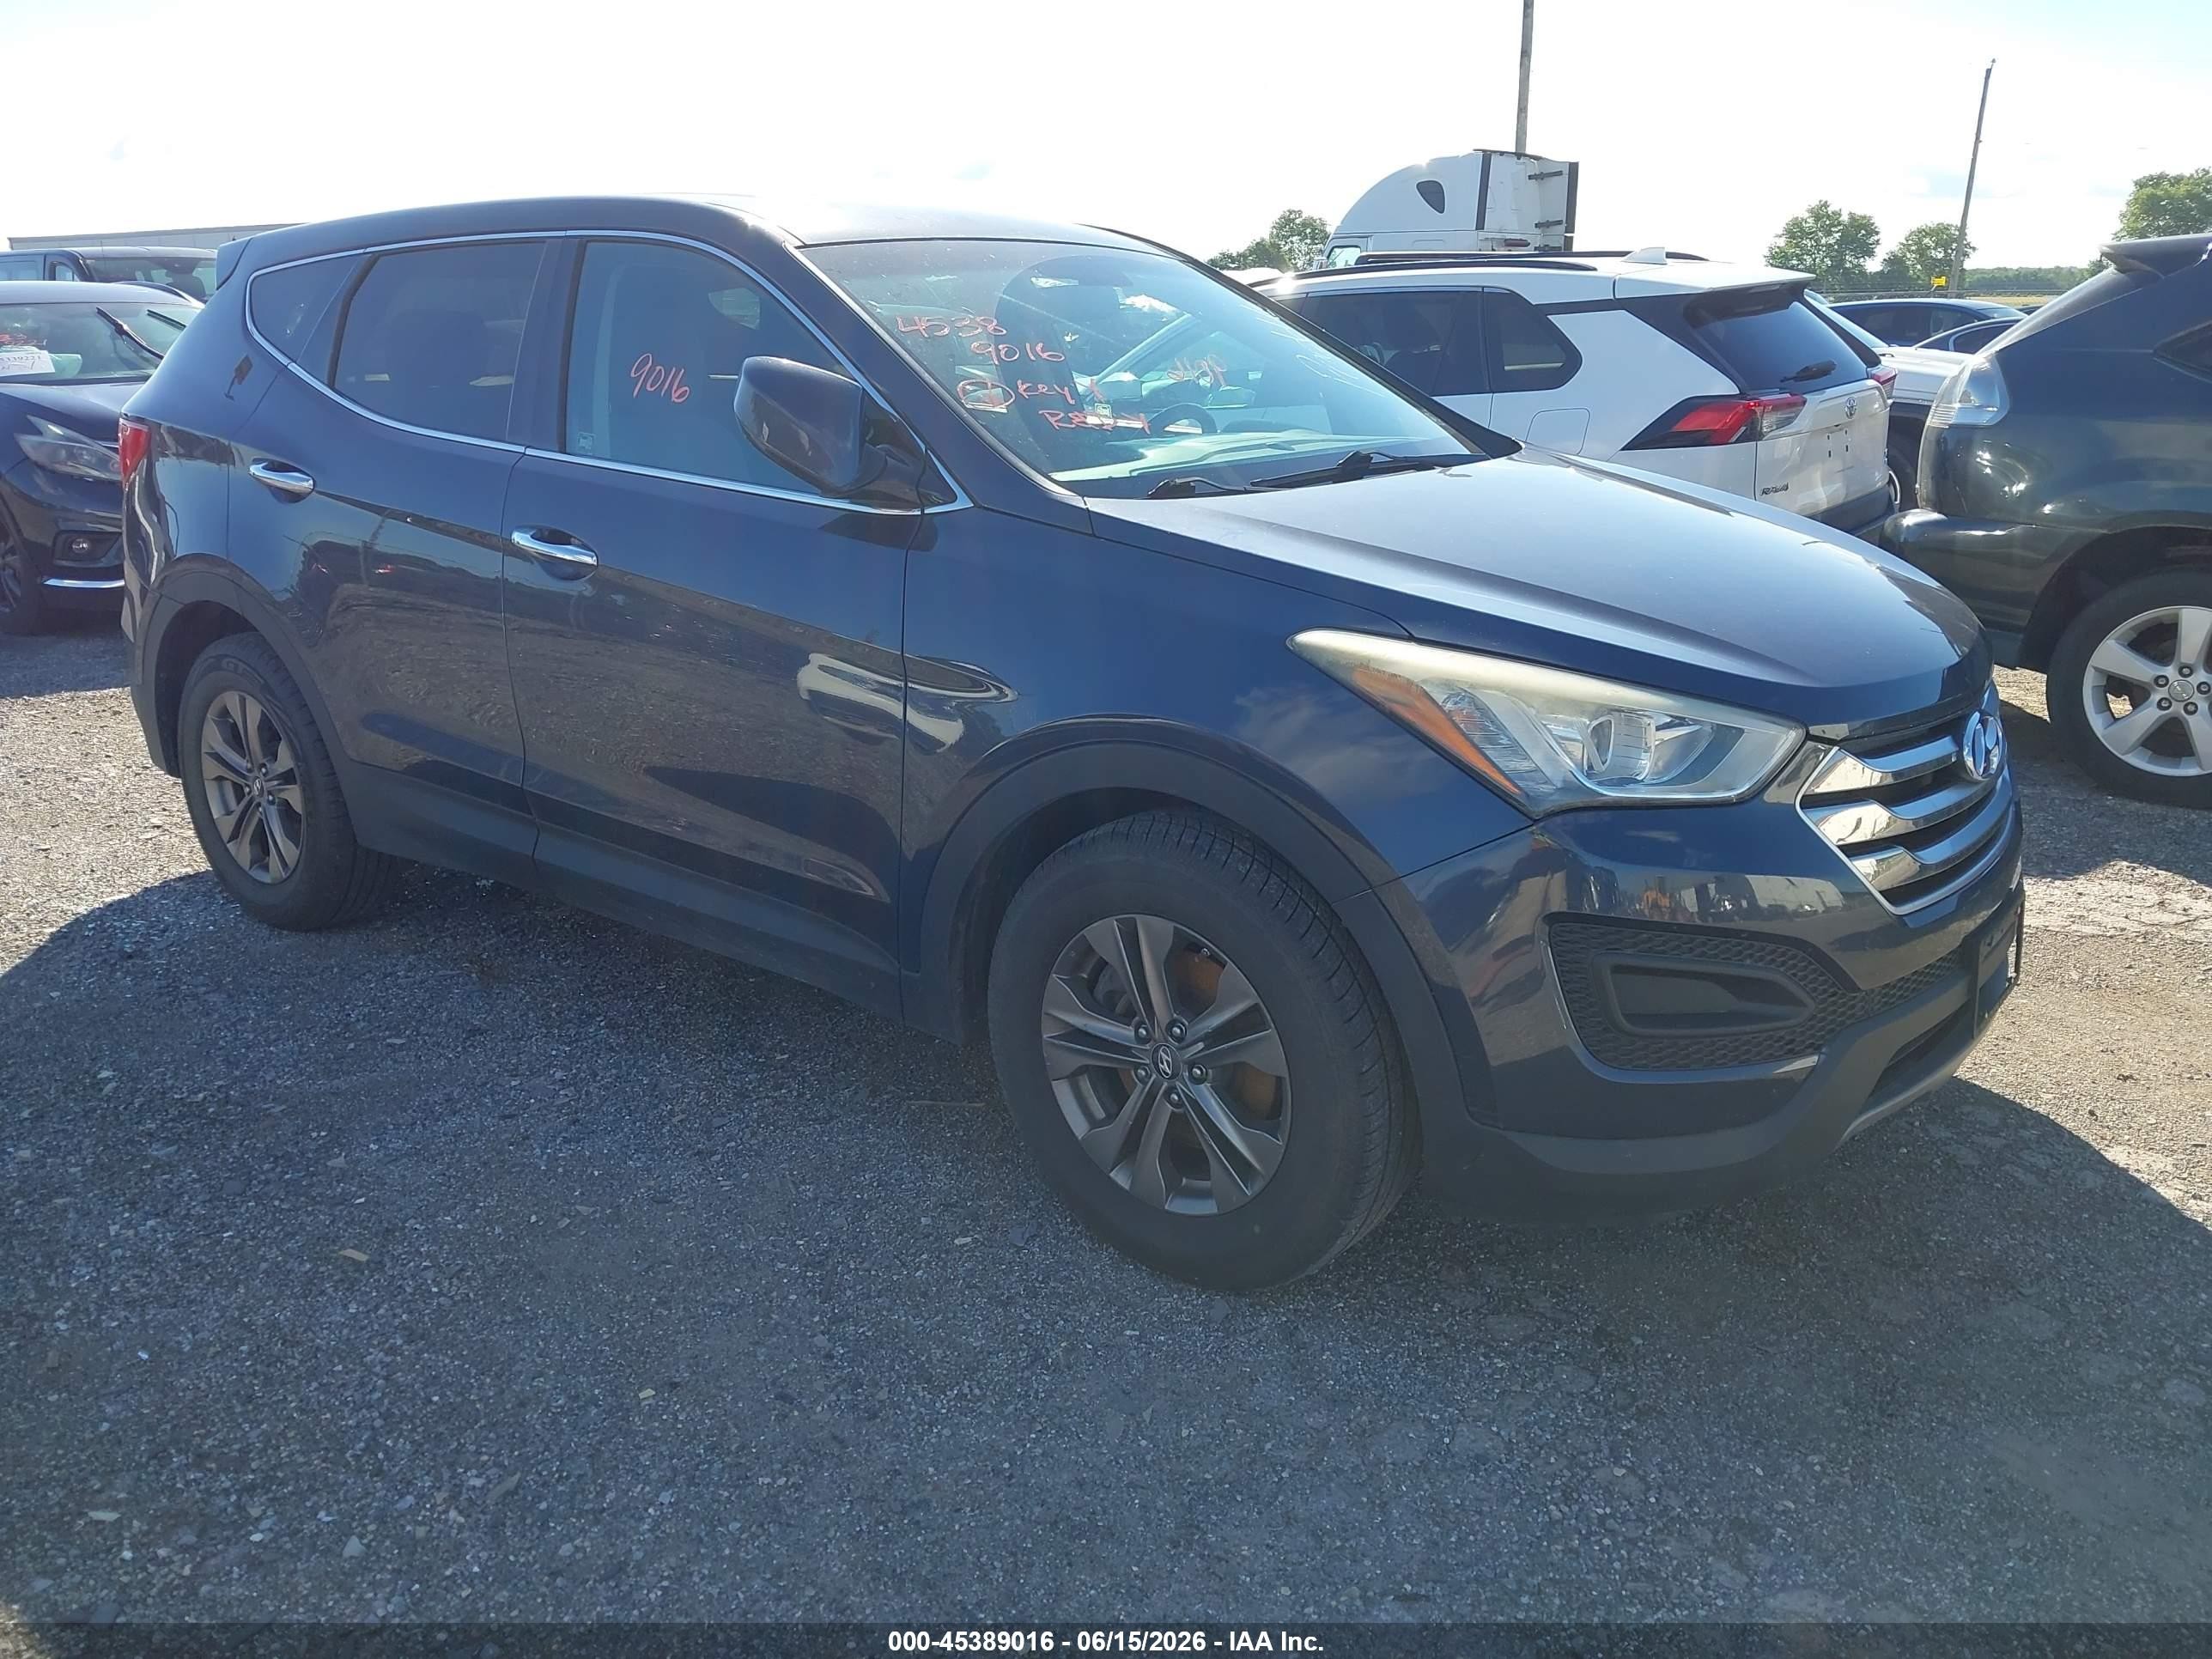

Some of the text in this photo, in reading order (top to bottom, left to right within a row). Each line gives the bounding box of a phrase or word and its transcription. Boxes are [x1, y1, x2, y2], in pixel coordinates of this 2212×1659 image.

[896, 316, 1007, 338] 4538
[970, 341, 1066, 365] 9016
[630, 353, 690, 403] 9016
